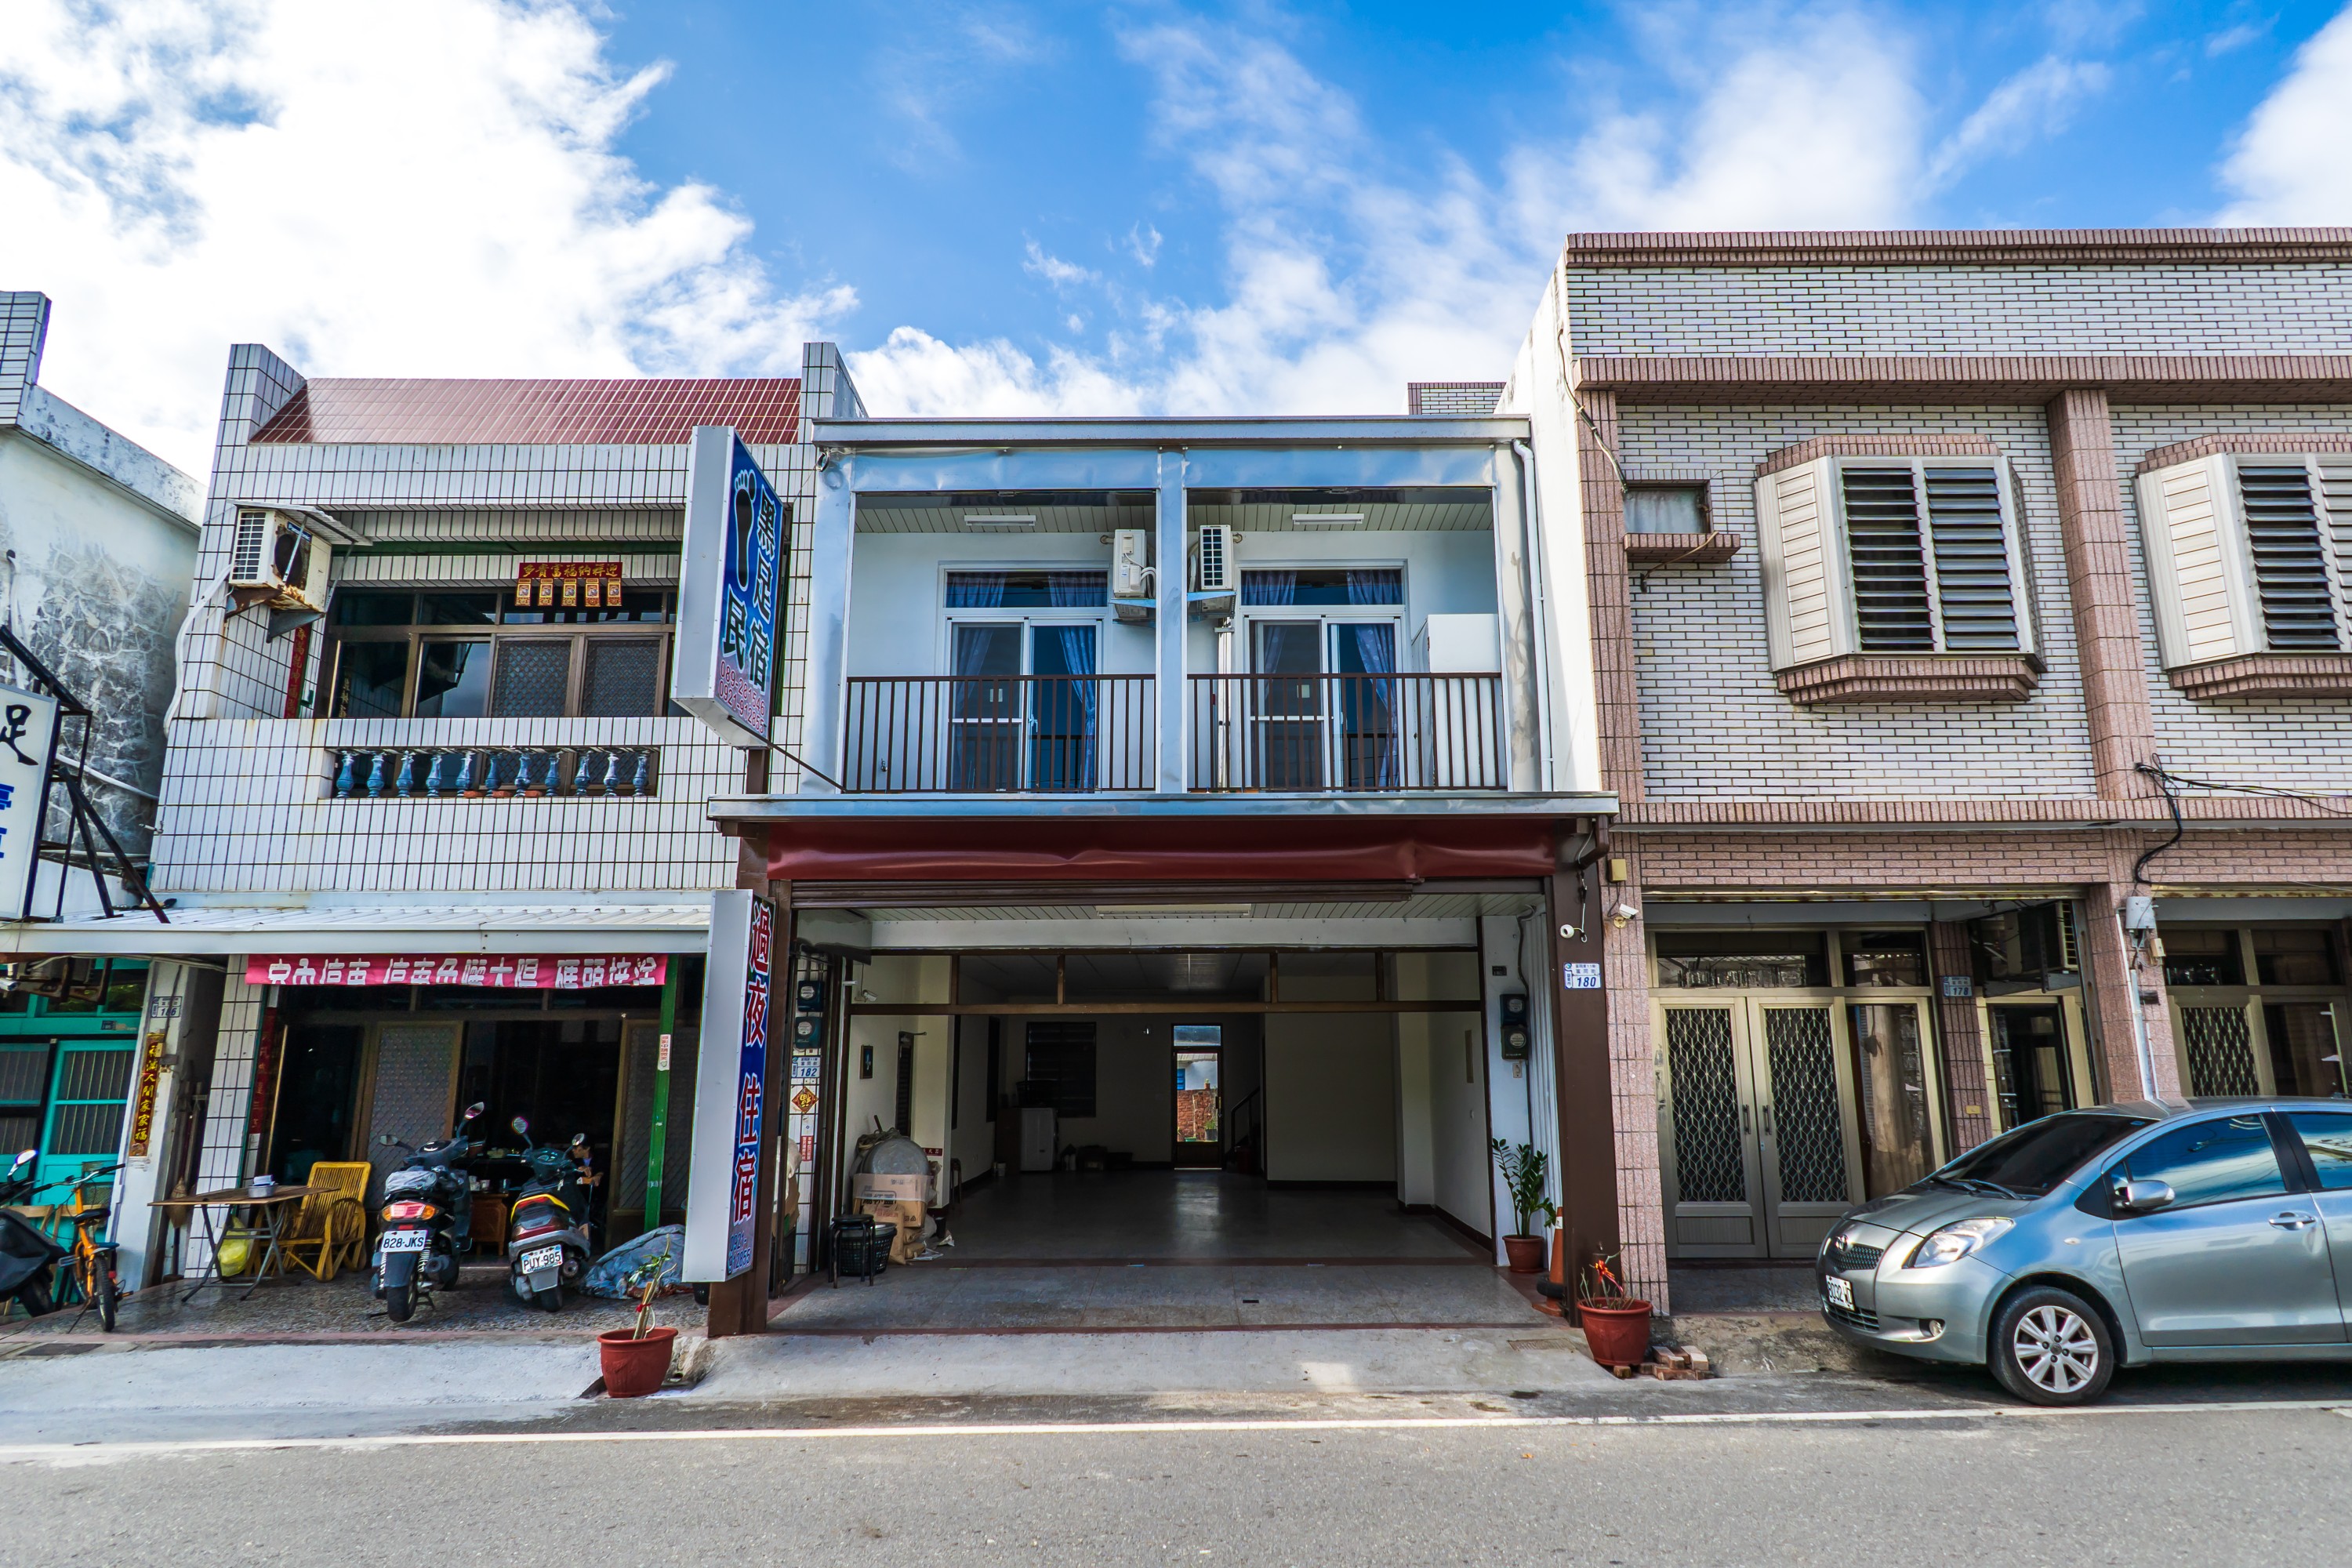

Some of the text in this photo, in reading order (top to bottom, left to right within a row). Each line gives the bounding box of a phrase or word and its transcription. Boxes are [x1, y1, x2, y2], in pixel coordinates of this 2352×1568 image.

[720, 660, 765, 717] 089-281546
[719, 681, 765, 735] 0921-912855
[746, 906, 771, 1047] 過夜
[1577, 977, 1596, 987] 180
[1953, 987, 1969, 996] 178
[800, 1068, 817, 1077] 182
[734, 1074, 760, 1225] 住宿
[383, 1237, 424, 1248] 828-JKS
[523, 1251, 561, 1270] PUY-985
[728, 1247, 751, 1275] 912855
